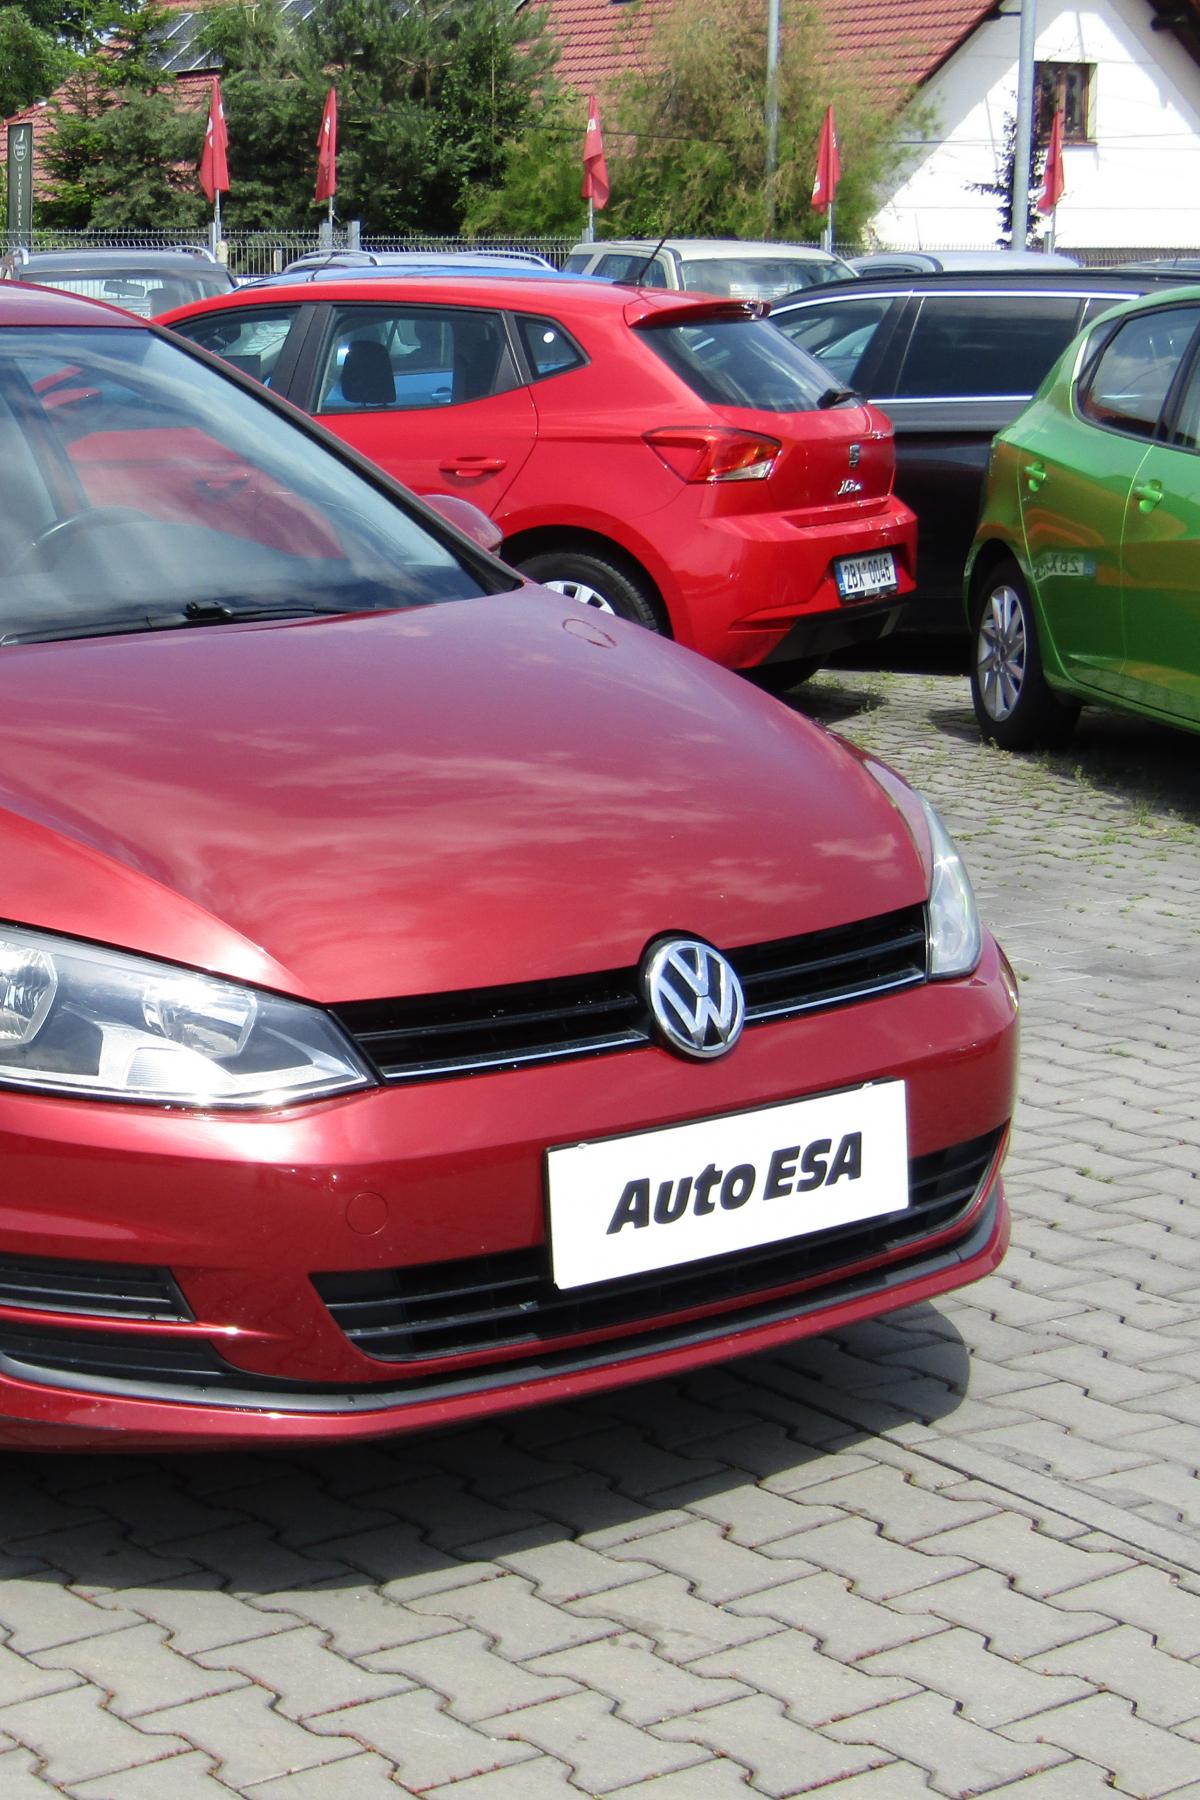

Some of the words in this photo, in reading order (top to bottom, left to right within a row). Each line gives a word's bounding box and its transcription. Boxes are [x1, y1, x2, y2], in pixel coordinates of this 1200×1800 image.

[844, 560, 865, 590] 2BX
[868, 556, 892, 586] 0046
[606, 1163, 757, 1236] Auto
[763, 1131, 863, 1201] ESA
